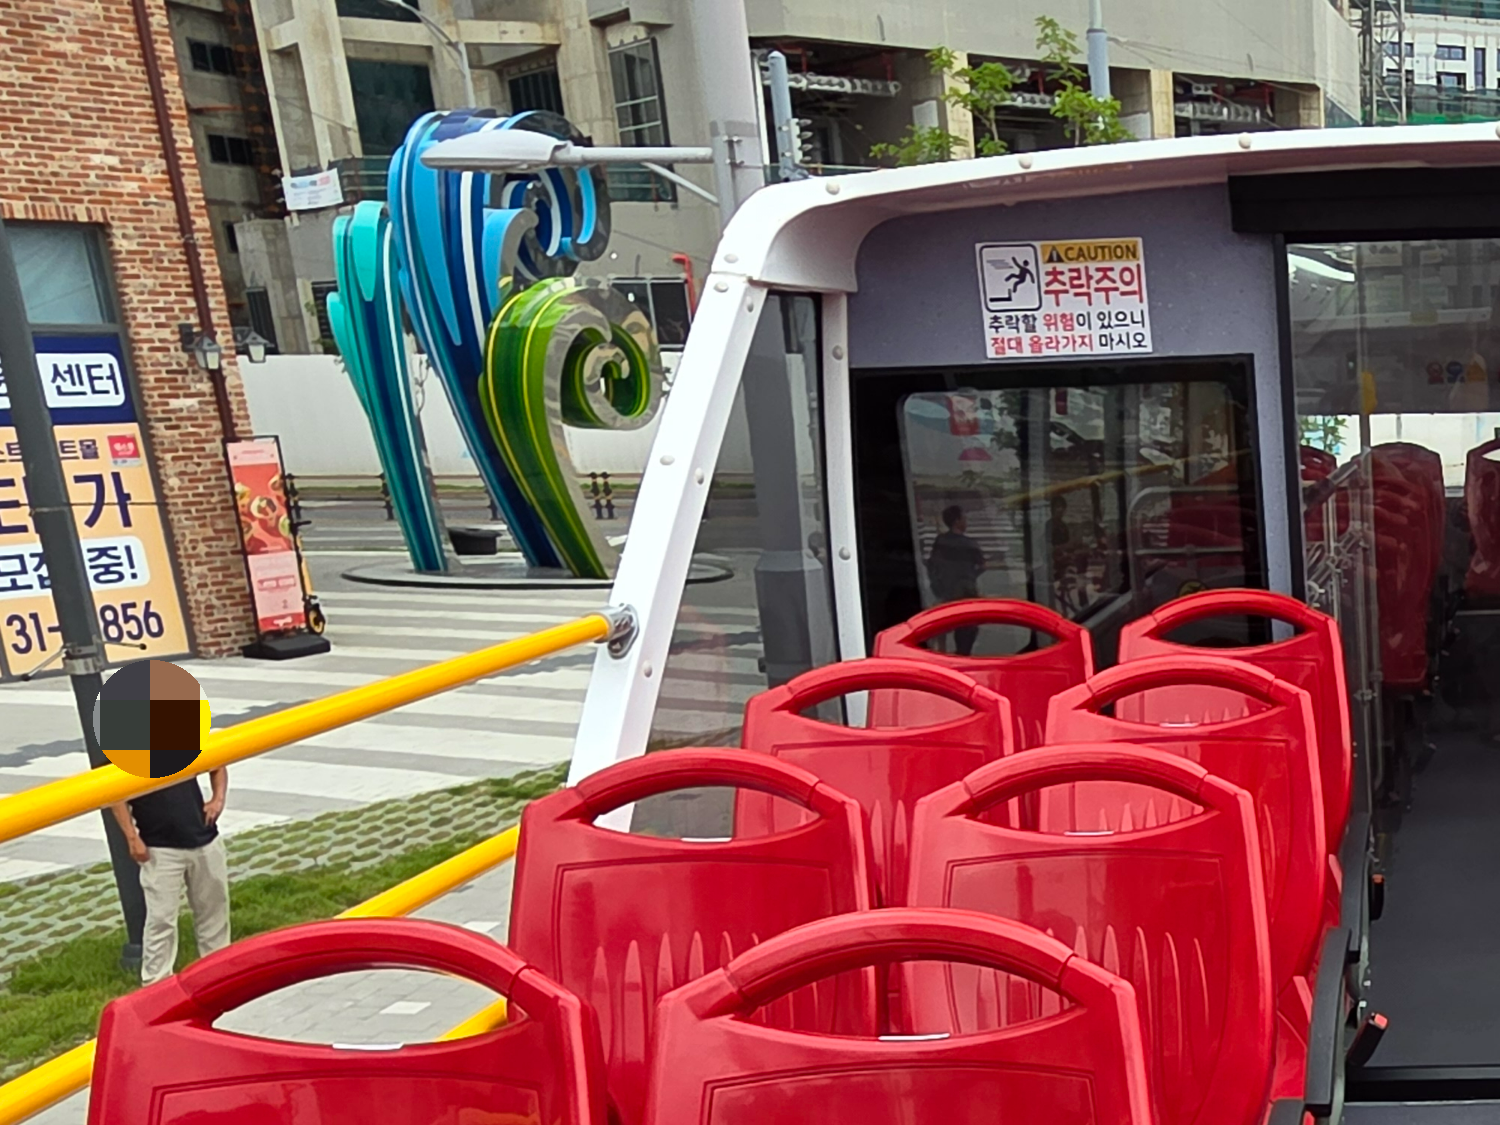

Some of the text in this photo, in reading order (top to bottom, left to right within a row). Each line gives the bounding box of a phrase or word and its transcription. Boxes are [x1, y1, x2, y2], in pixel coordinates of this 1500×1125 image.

[1064, 244, 1138, 262] CAUTION
[1043, 263, 1144, 307] 추락주의
[988, 309, 1145, 333] 추락할 위험이 있으니
[991, 331, 1148, 355] 절대 올라가지 마시오
[51, 363, 120, 396] 센터
[86, 544, 138, 584] 중!
